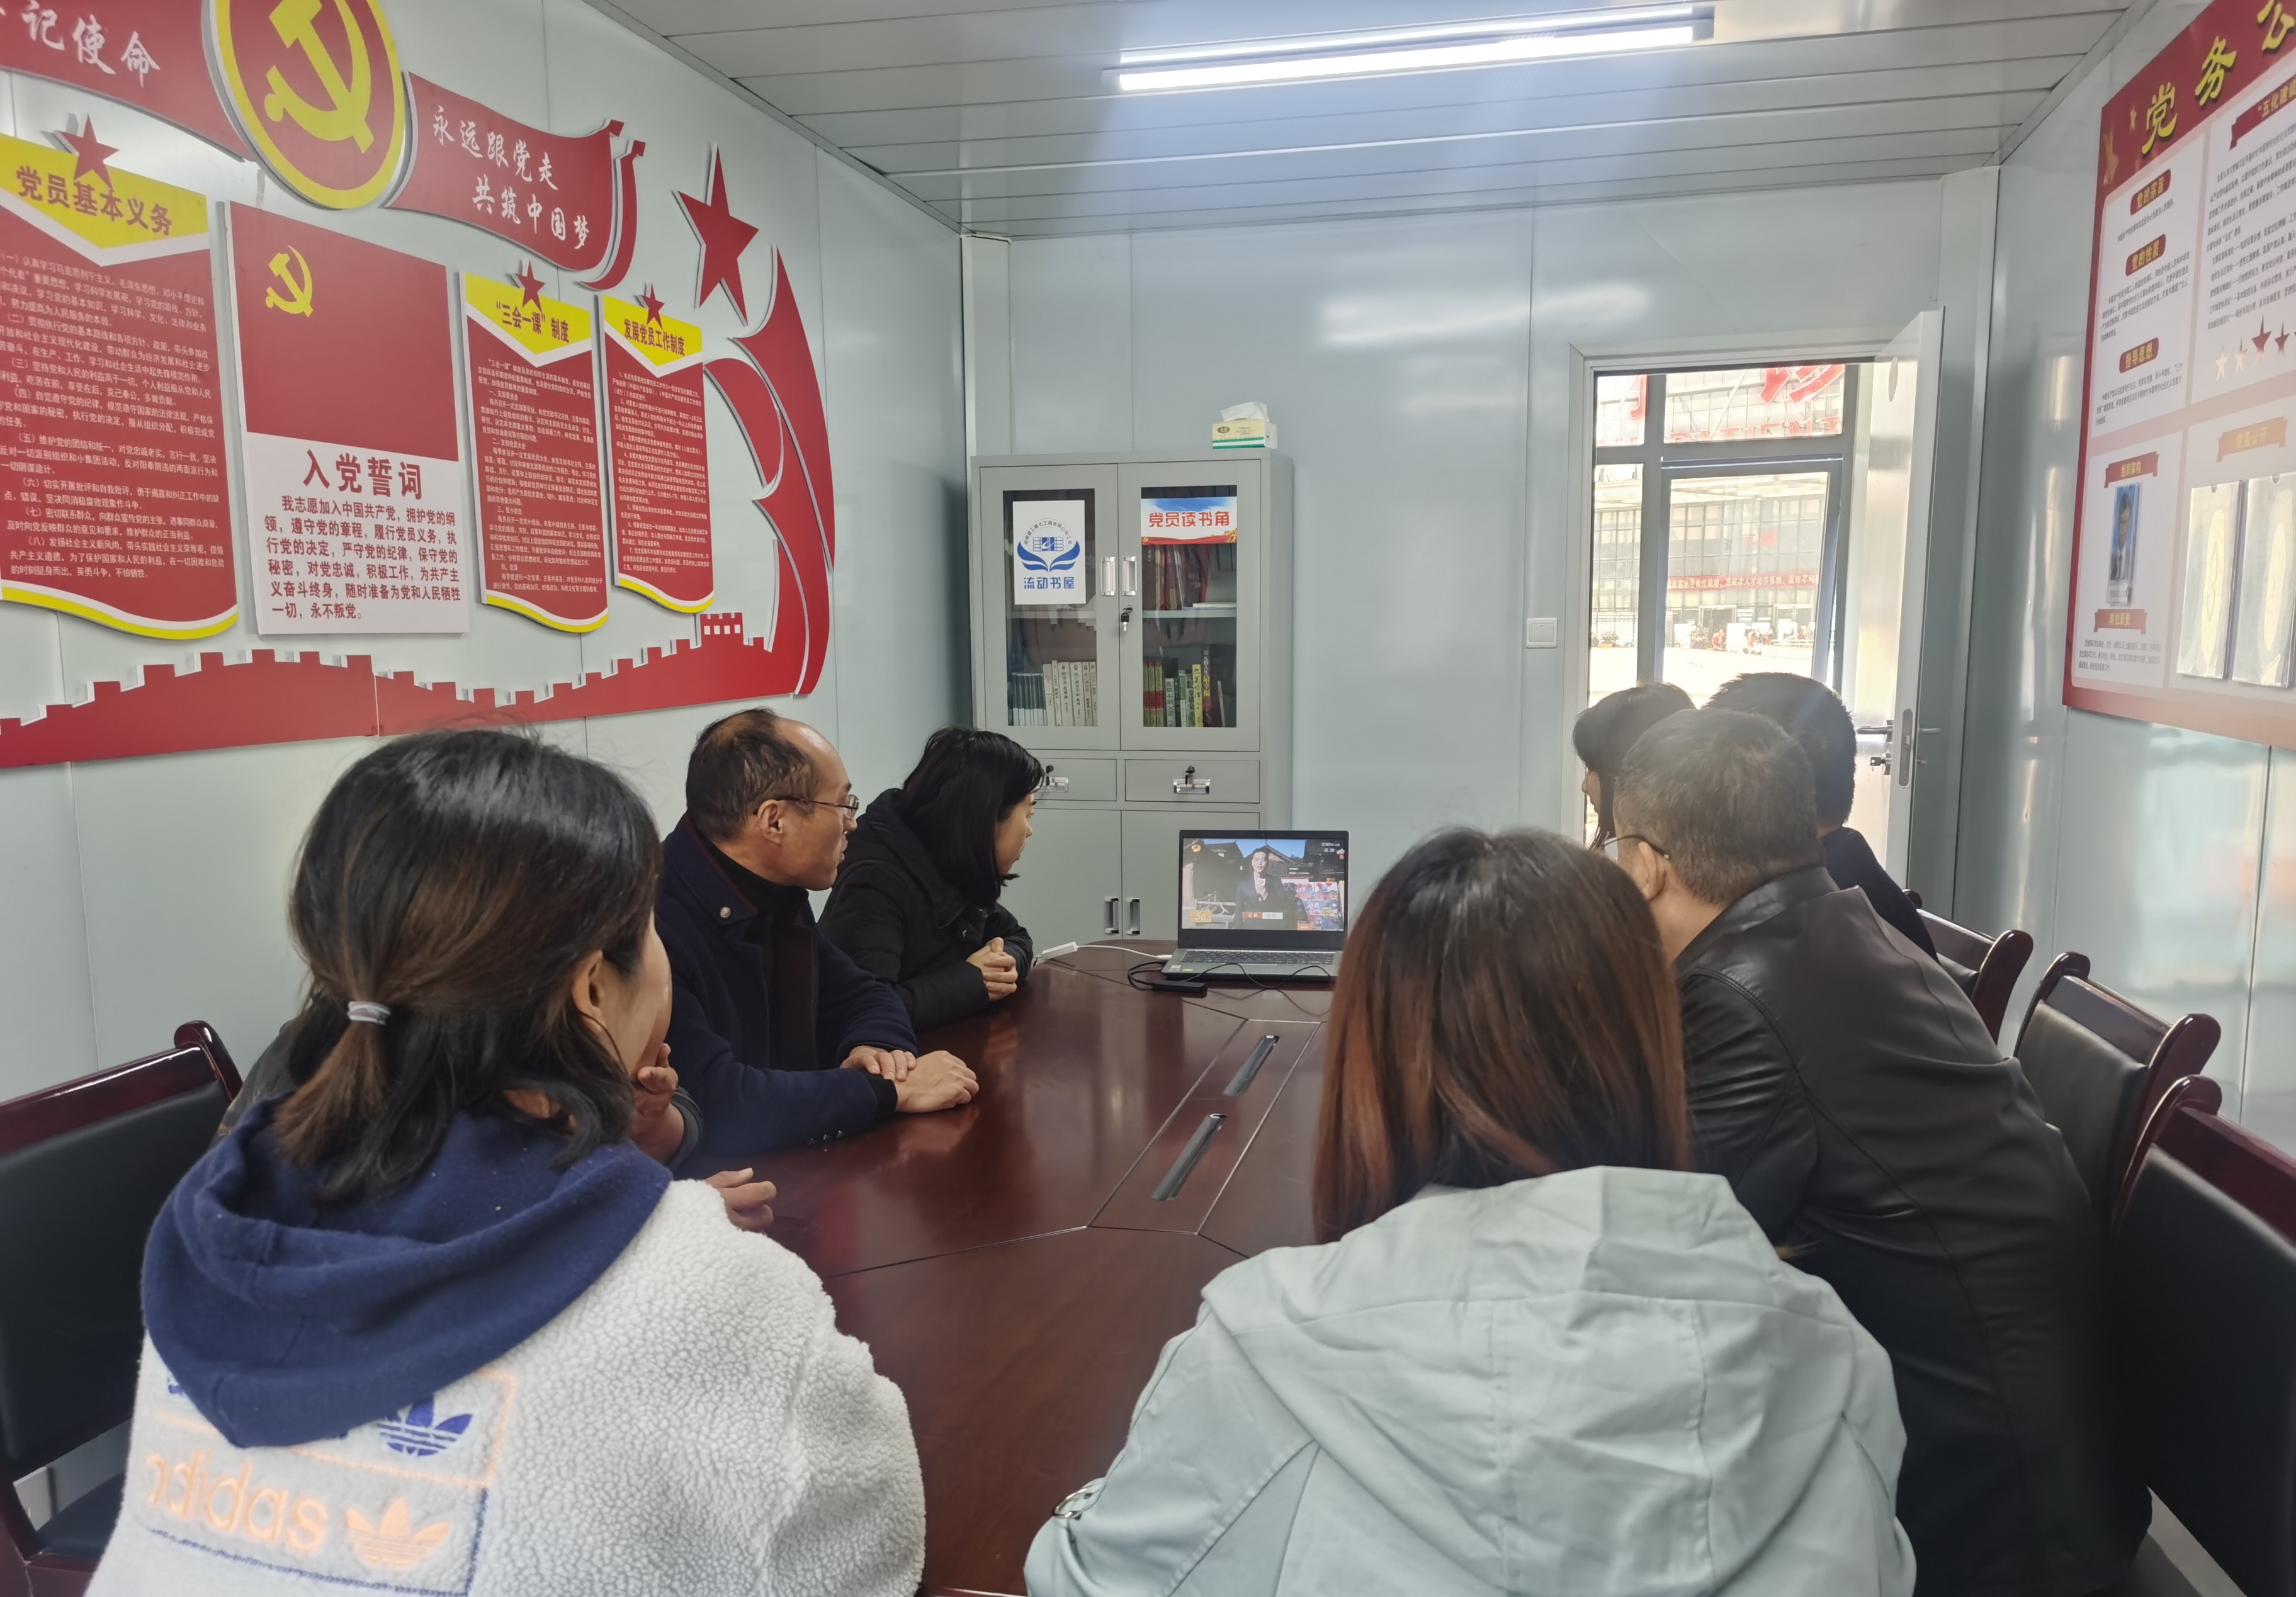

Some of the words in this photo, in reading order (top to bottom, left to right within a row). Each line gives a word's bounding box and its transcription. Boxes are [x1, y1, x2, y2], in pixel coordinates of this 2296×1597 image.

[433, 104, 558, 190] 永远跟党走
[16, 164, 172, 236] 党员基本义务
[472, 174, 590, 249] 共筑中国梦
[624, 319, 685, 356] 发展党员工作制度
[303, 449, 422, 500] 入党誓词
[281, 495, 455, 526] 我志愿加入中国共产党，拥护党的纲
[1149, 511, 1230, 528] 党员读书角
[264, 515, 457, 545] 领，遵守党的章程，履行党员义务，执
[266, 537, 458, 564] 行党的决定，严守党的纪律，保守党的
[268, 559, 459, 582] 秘密，对党忠诚，积极工作，为共产主
[1024, 577, 1075, 589] 流动书屋
[271, 581, 461, 601] 义奋斗终身，随时准备为党和人民牺牲
[272, 602, 362, 619] 一切，永不叛党。
[1194, 912, 1207, 921] 5G
